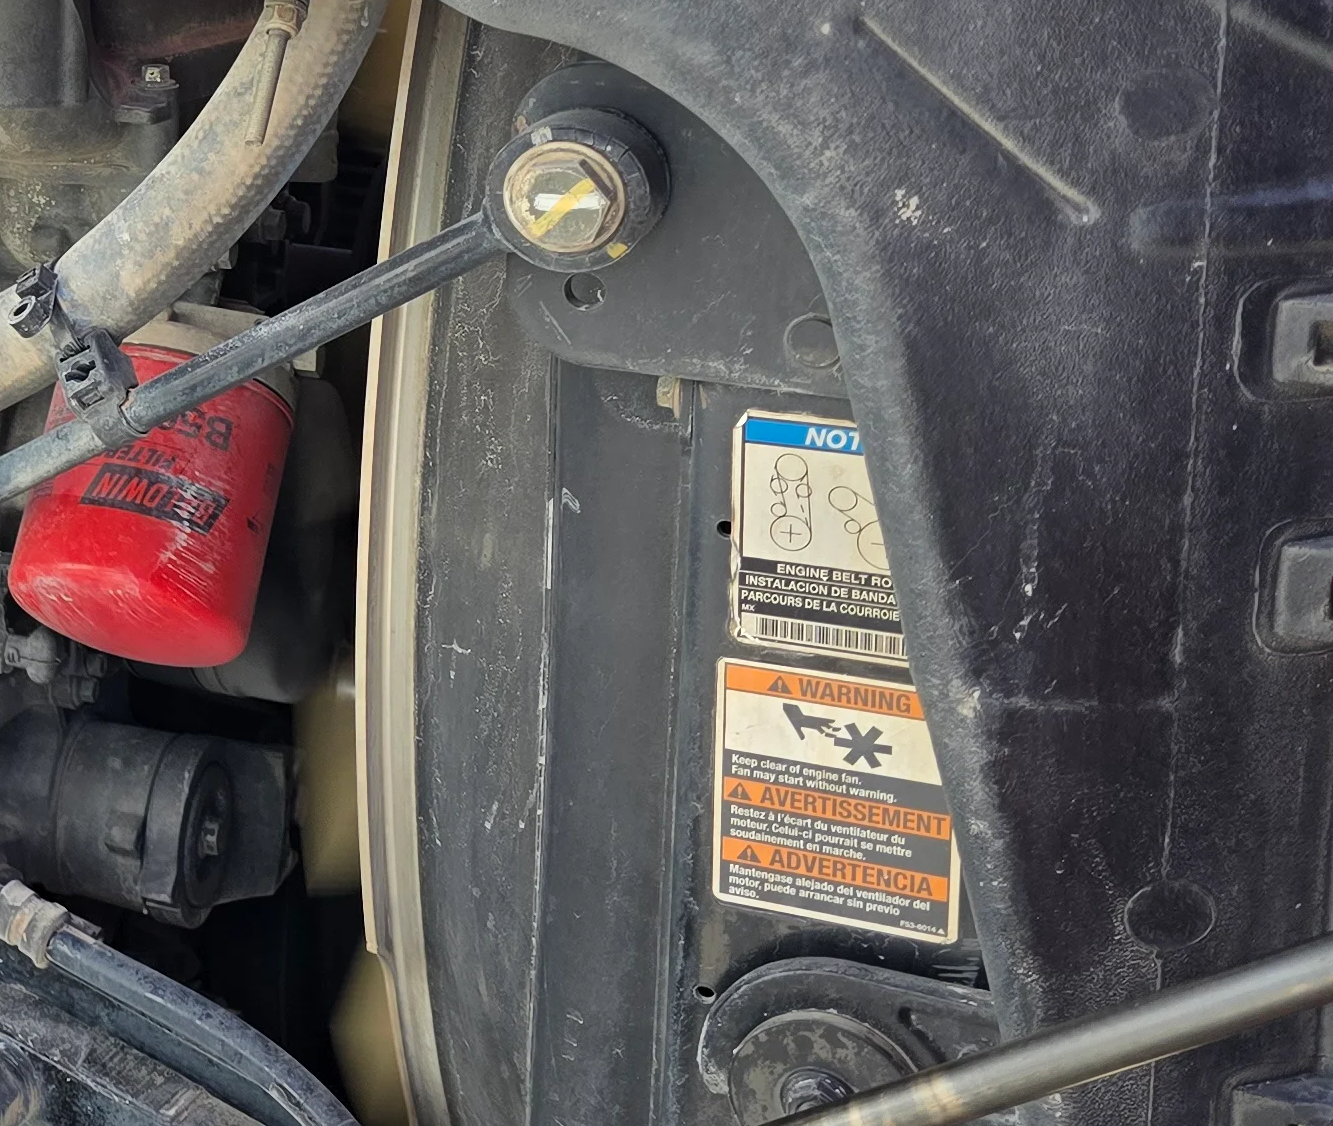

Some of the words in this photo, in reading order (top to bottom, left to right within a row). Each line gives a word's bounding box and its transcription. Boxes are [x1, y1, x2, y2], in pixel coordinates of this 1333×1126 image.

[804, 427, 862, 451] NOT
[745, 574, 828, 596] INSTALACION
[831, 587, 849, 598] DE
[851, 590, 896, 605] BANDA
[776, 563, 829, 580] ENGINE
[832, 570, 868, 586] BELT
[871, 577, 893, 589] RO
[741, 589, 803, 608] PARCOURS
[804, 598, 821, 610] DE
[822, 601, 837, 613] LA
[839, 603, 900, 622] COURROIE
[741, 603, 755, 612] MX
[798, 677, 912, 714] WARNING
[731, 753, 758, 769] Keep
[760, 759, 786, 772] clear
[789, 764, 800, 774] of
[802, 767, 839, 782] engine
[841, 774, 862, 785] fan.
[731, 766, 750, 777] Fan
[752, 771, 775, 785] may
[778, 775, 803, 786] start
[806, 779, 847, 794] without
[849, 788, 897, 803] warning.
[730, 805, 766, 820] Restez
[768, 810, 775, 821] à
[777, 813, 812, 828] l'écart
[814, 820, 828, 831] du
[831, 823, 888, 842] ventilateur
[891, 835, 905, 845] du
[759, 786, 947, 836] AVERTISSEMENT
[730, 818, 770, 831] moteur.
[772, 824, 812, 839] Celui-ci
[815, 832, 858, 848] pourrait
[860, 841, 873, 851] se
[876, 844, 912, 858] mettre
[730, 828, 804, 850] soudainement
[806, 842, 820, 852] en
[822, 845, 866, 861] marche.
[729, 864, 793, 884] Mantengase
[795, 878, 834, 893] alejado
[836, 884, 854, 896] del
[856, 888, 910, 907] ventilador
[913, 900, 930, 911] del
[769, 849, 933, 897] ADVERTENCIA
[729, 885, 759, 899] aviso.
[729, 876, 762, 889] motor,
[764, 882, 796, 896] puede
[799, 889, 844, 905] arrancar
[847, 897, 863, 908] sin
[865, 901, 900, 916] previo
